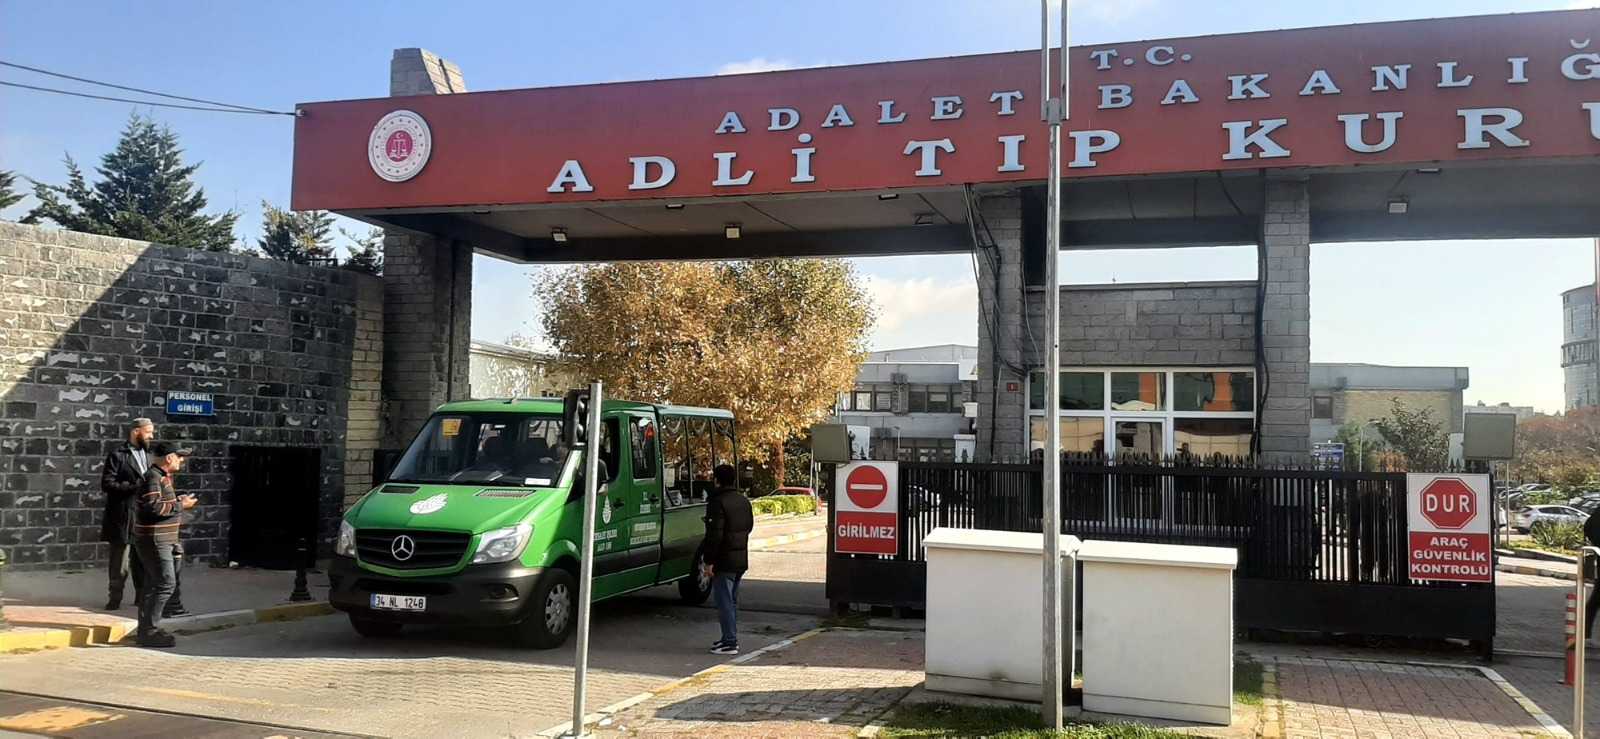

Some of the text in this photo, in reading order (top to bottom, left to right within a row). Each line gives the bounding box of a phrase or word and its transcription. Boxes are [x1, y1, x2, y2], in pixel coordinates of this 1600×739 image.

[1090, 45, 1192, 70] T.C.
[715, 91, 1024, 134] ADALET
[547, 102, 1600, 192] ADLİ TIP KUR
[169, 392, 212, 401] PERSONEL
[1426, 494, 1470, 512] DUR
[838, 522, 895, 539] GİRİLMEZ
[1430, 537, 1469, 548] ARAÇ
[1413, 549, 1486, 562] GÜVENLİK
[1411, 563, 1489, 576] KONTROLÜ
[375, 596, 385, 606] 34
